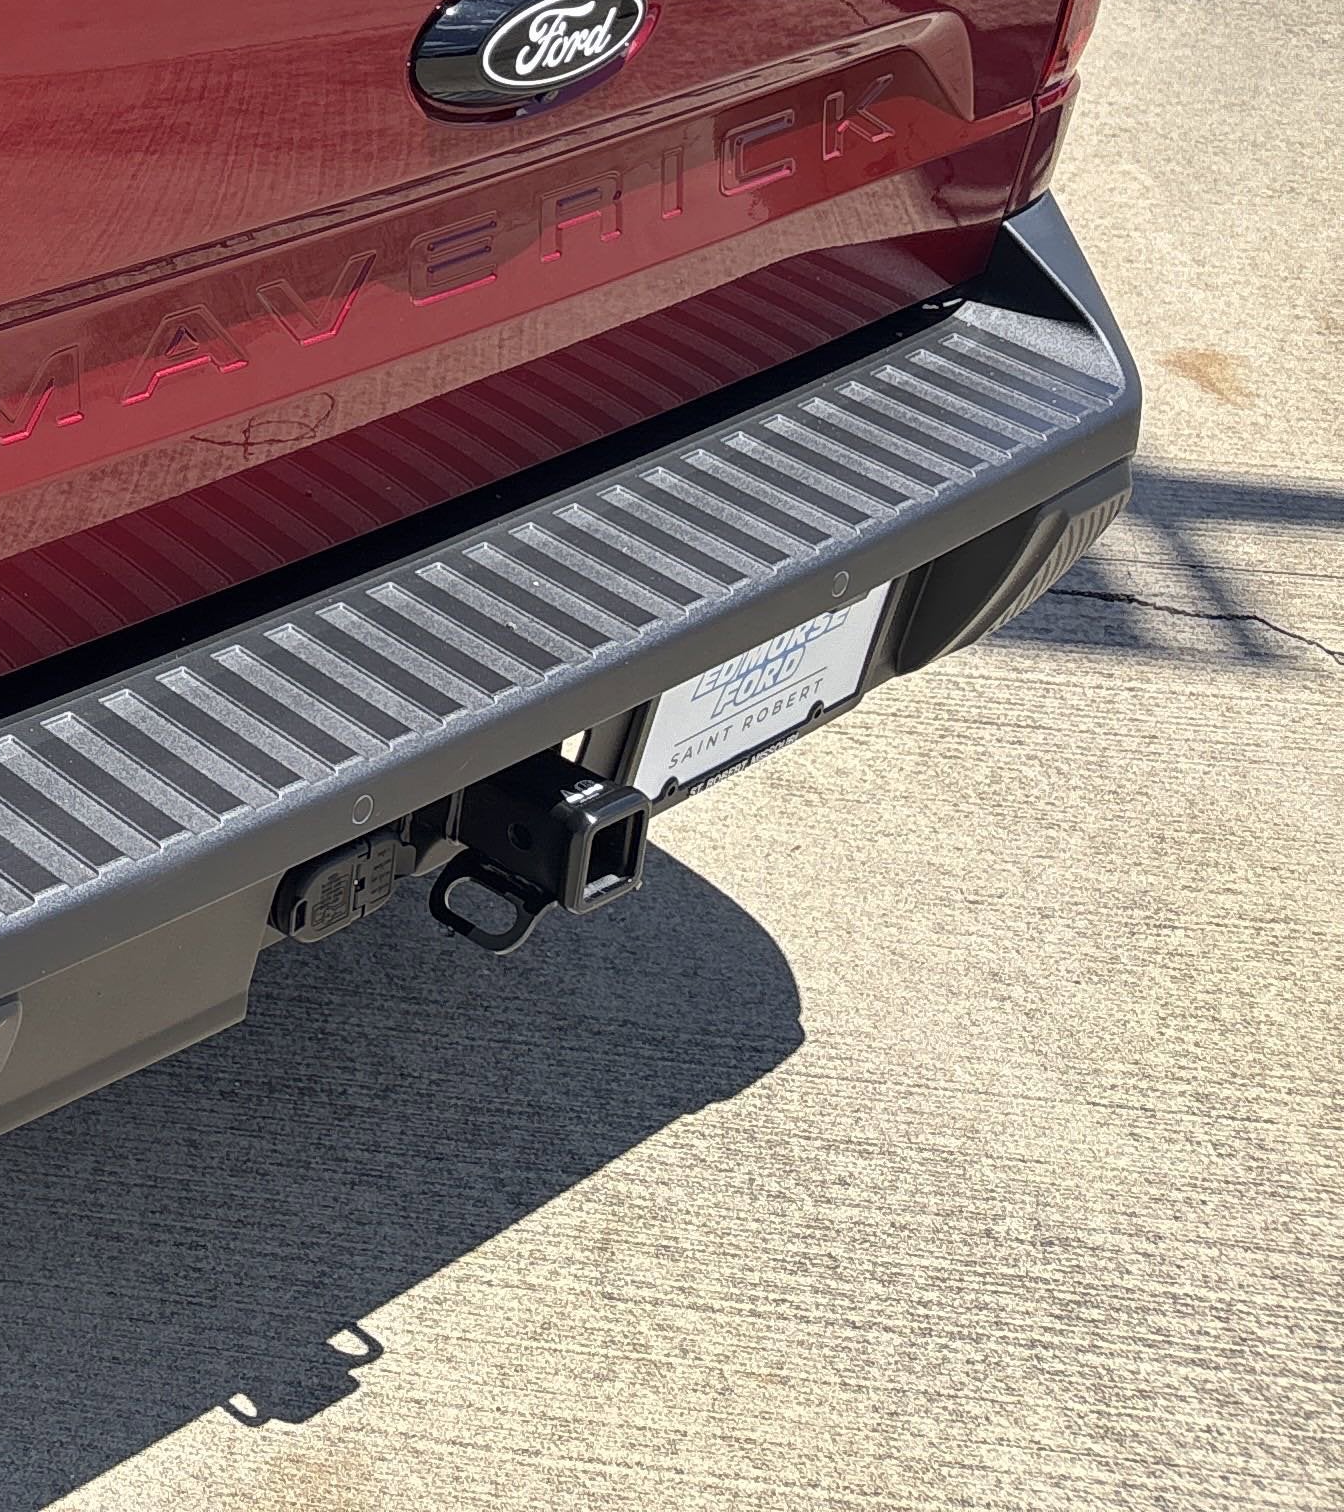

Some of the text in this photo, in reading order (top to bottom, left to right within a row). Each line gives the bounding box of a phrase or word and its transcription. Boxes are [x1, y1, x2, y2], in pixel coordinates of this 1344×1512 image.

[515, 0, 617, 76] Ford
[710, 645, 807, 721] FORD
[667, 678, 825, 769] SAINT ROBERT
